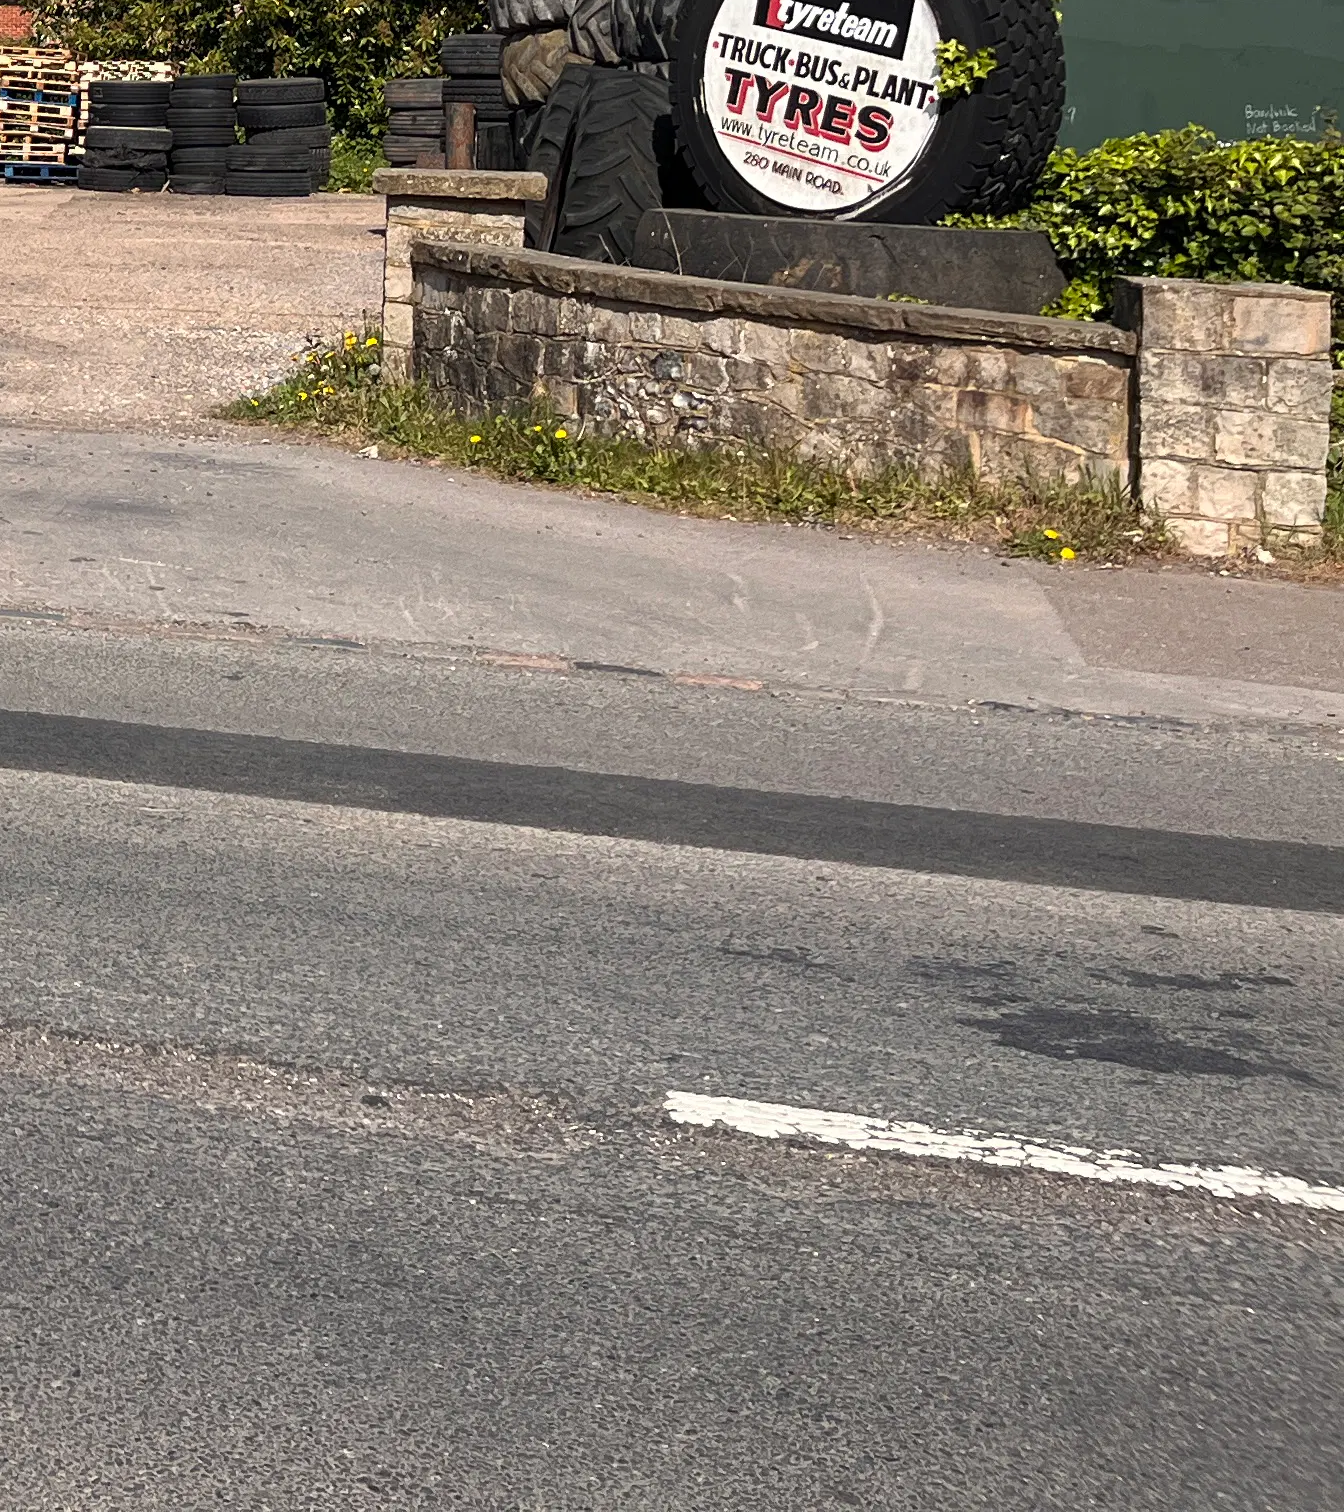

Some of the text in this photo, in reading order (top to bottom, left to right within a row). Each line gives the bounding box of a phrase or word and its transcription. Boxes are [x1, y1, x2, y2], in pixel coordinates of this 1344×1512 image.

[718, 32, 935, 111] TRUCK BUS & PLANT
[723, 67, 895, 153] TYRES
[721, 116, 893, 178] www.tyreteam.co.uk
[771, 161, 803, 183] MAIN
